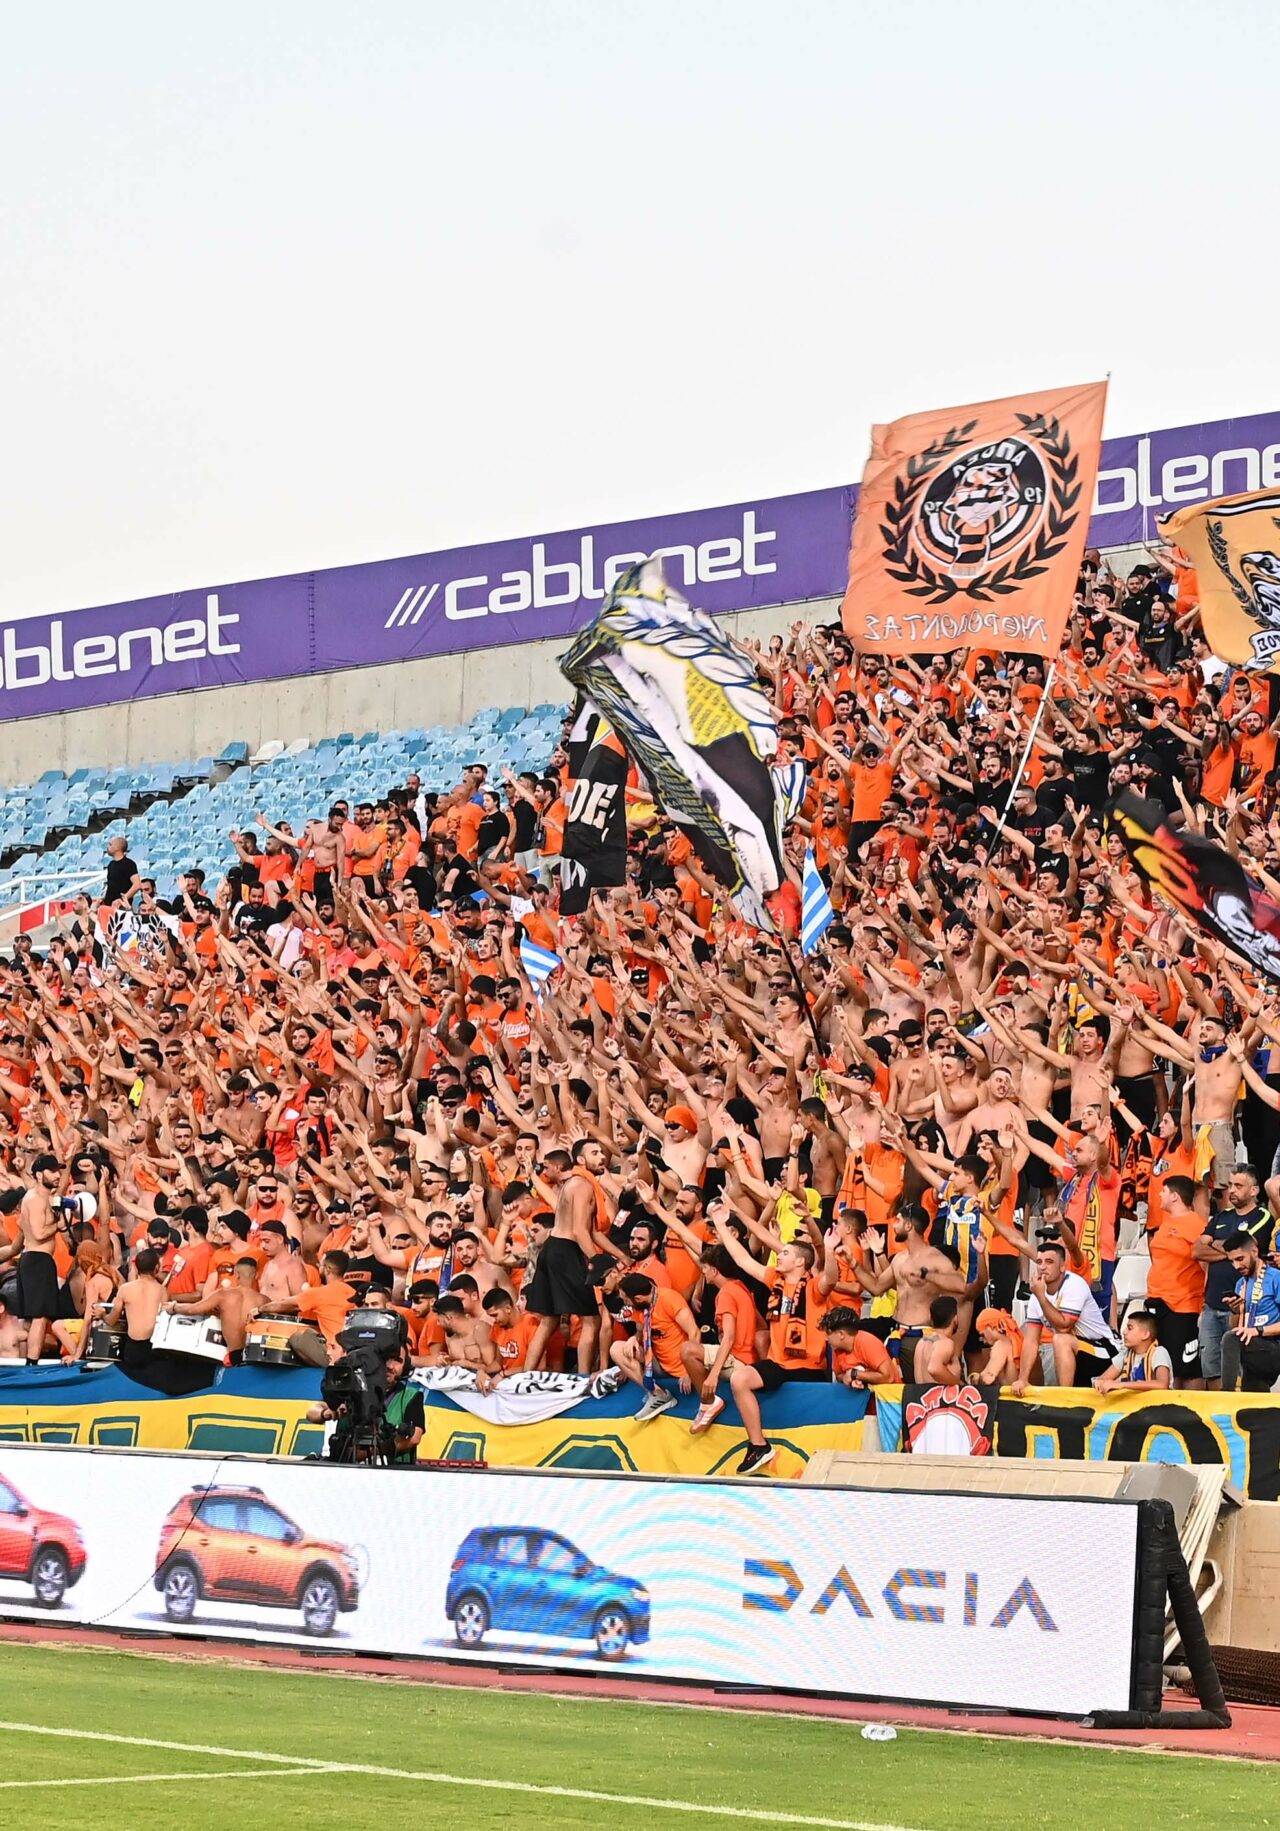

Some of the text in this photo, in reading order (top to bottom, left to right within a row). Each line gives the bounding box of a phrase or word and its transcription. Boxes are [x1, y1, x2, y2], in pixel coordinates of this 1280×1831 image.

[444, 511, 776, 621] cablenet
[0, 594, 241, 690] blenet
[743, 1557, 1059, 1633] DACIA
